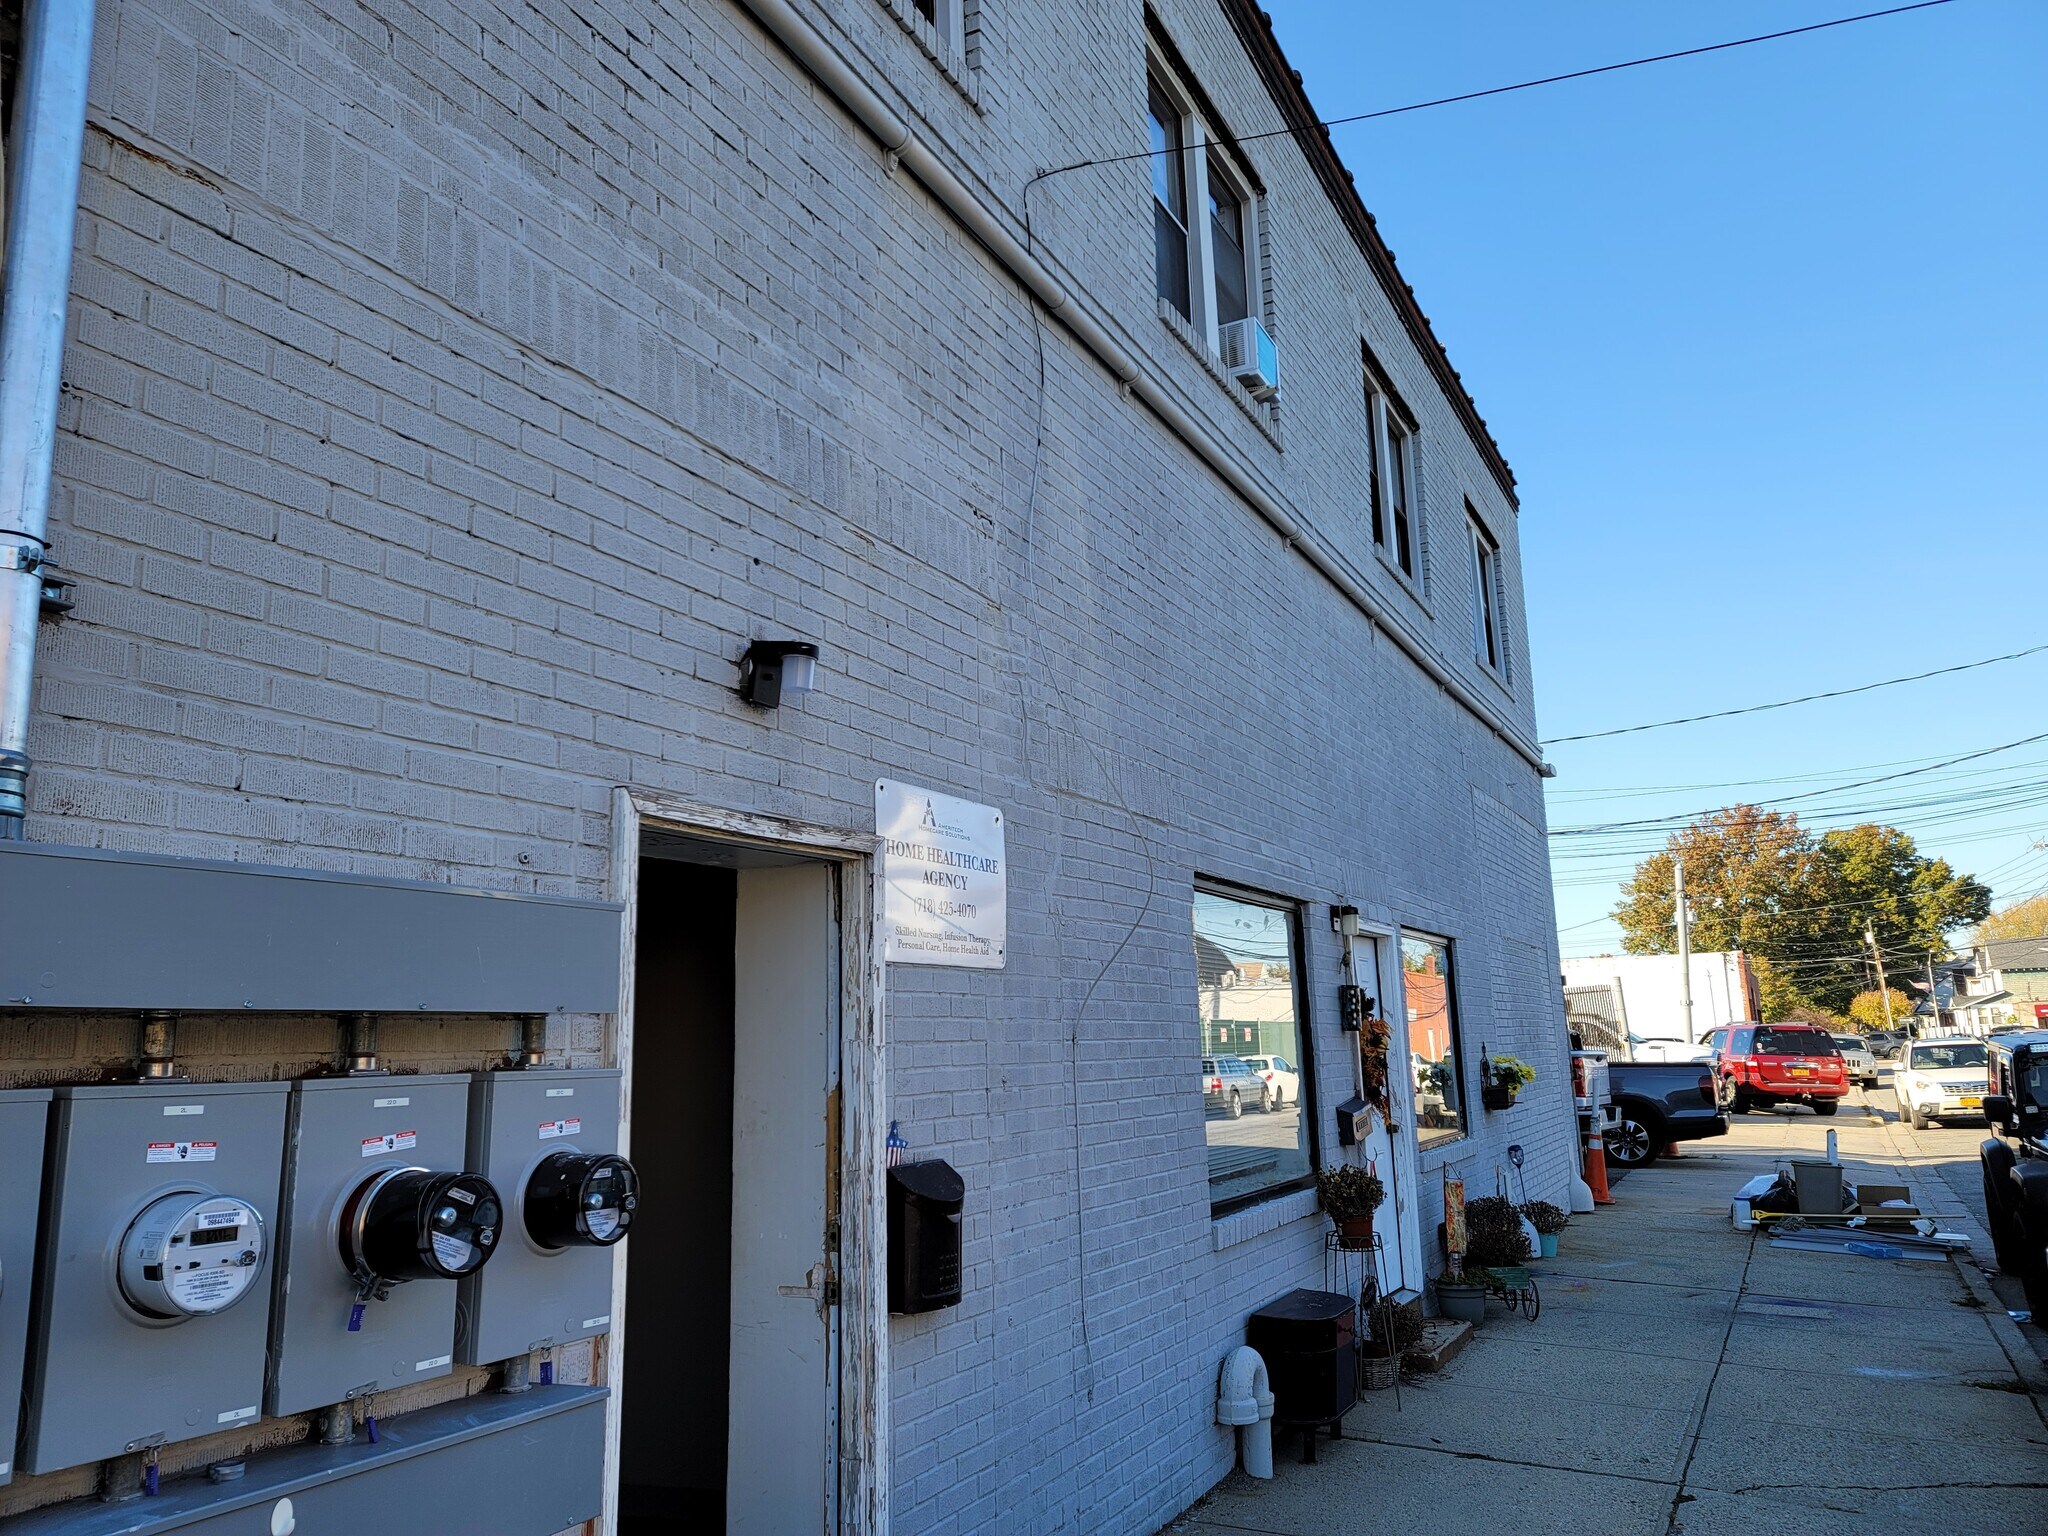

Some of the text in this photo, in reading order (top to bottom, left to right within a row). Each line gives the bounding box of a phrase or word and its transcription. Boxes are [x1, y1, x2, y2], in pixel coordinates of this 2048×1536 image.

[918, 824, 970, 841] HOMECARE SOLUTIONS
[938, 822, 964, 834] AMERITECH
[886, 838, 999, 874] HOME HEALTHCARE
[922, 869, 968, 890] AGENCY
[914, 896, 976, 919] (718) 425-4070
[895, 926, 917, 938] Skilled
[918, 928, 944, 942] Nursing,
[944, 930, 967, 942] Infusion
[898, 938, 990, 956] Personal Care, Home Health Aid
